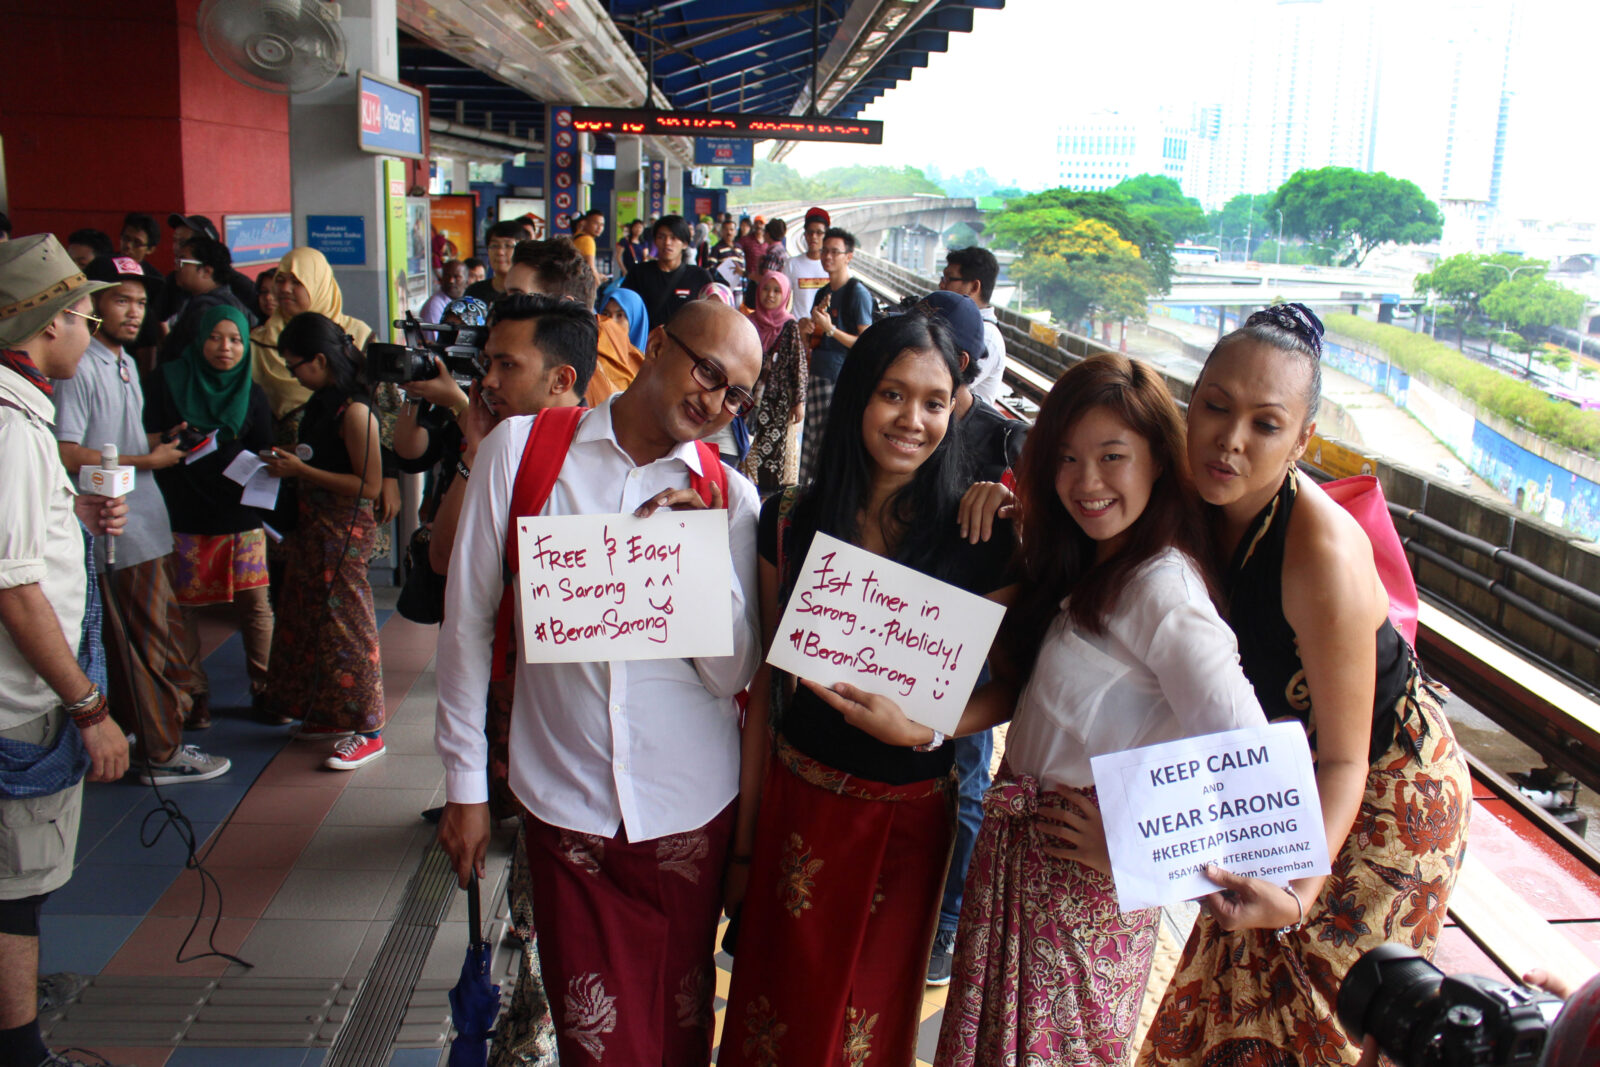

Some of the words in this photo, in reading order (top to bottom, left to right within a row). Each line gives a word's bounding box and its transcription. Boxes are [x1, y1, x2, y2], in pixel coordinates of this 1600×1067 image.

[362, 99, 380, 128] KJ14
[384, 104, 401, 131] Pasar
[401, 109, 416, 134] Seni
[530, 582, 550, 600] in
[558, 577, 626, 604] Sarong
[534, 608, 668, 645] #BeraniSarong
[920, 600, 941, 621] in
[789, 627, 917, 697] #BeraniSarong
[1150, 760, 1201, 787] KEEP
[1207, 745, 1269, 773] CALM
[1203, 782, 1225, 795] AND
[1138, 808, 1204, 839] WEAR
[1208, 788, 1300, 822] SARONG
[1152, 818, 1298, 863] #KERETAPISARONG
[1222, 841, 1311, 864] #TERENDAKIANZ
[1260, 860, 1314, 876] Seremban
